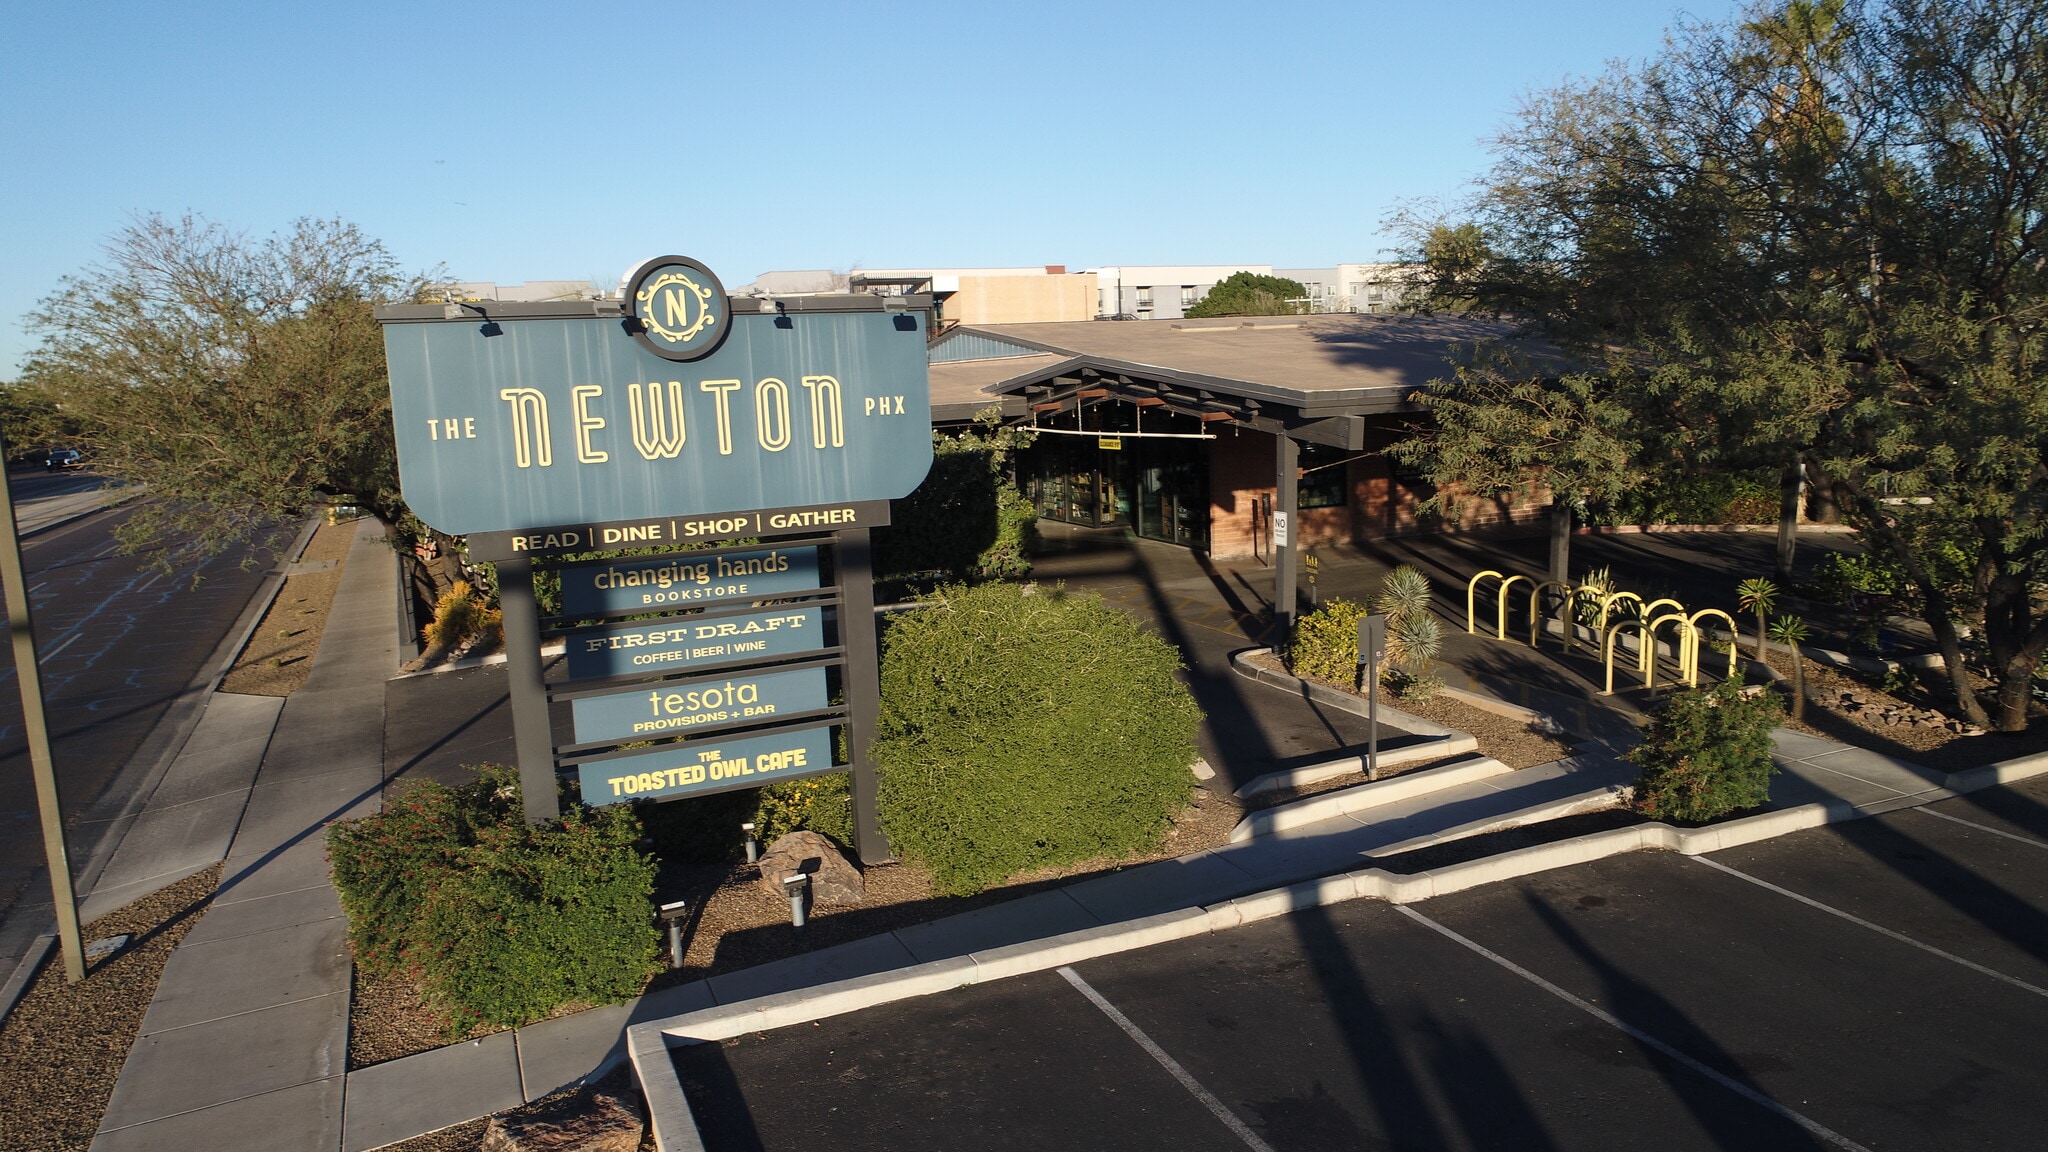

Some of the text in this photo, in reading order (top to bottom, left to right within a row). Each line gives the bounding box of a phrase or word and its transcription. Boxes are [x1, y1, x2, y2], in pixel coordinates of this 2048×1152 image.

[427, 374, 906, 468] THE NEWTON PHX
[512, 508, 856, 551] READ DINE SHOP GATHER
[1275, 518, 1286, 528] NO
[594, 551, 789, 589] changing hands
[643, 584, 748, 604] BOOKSTORE
[586, 615, 806, 651] FIRST DRAFT
[633, 640, 766, 665] COFFEE BEER WINE
[649, 682, 758, 716] tesota
[633, 711, 727, 732] PROVISIONS
[743, 704, 775, 717] BAR
[608, 748, 807, 796] TOASTED OWL CAFE
[698, 750, 721, 763] THE
